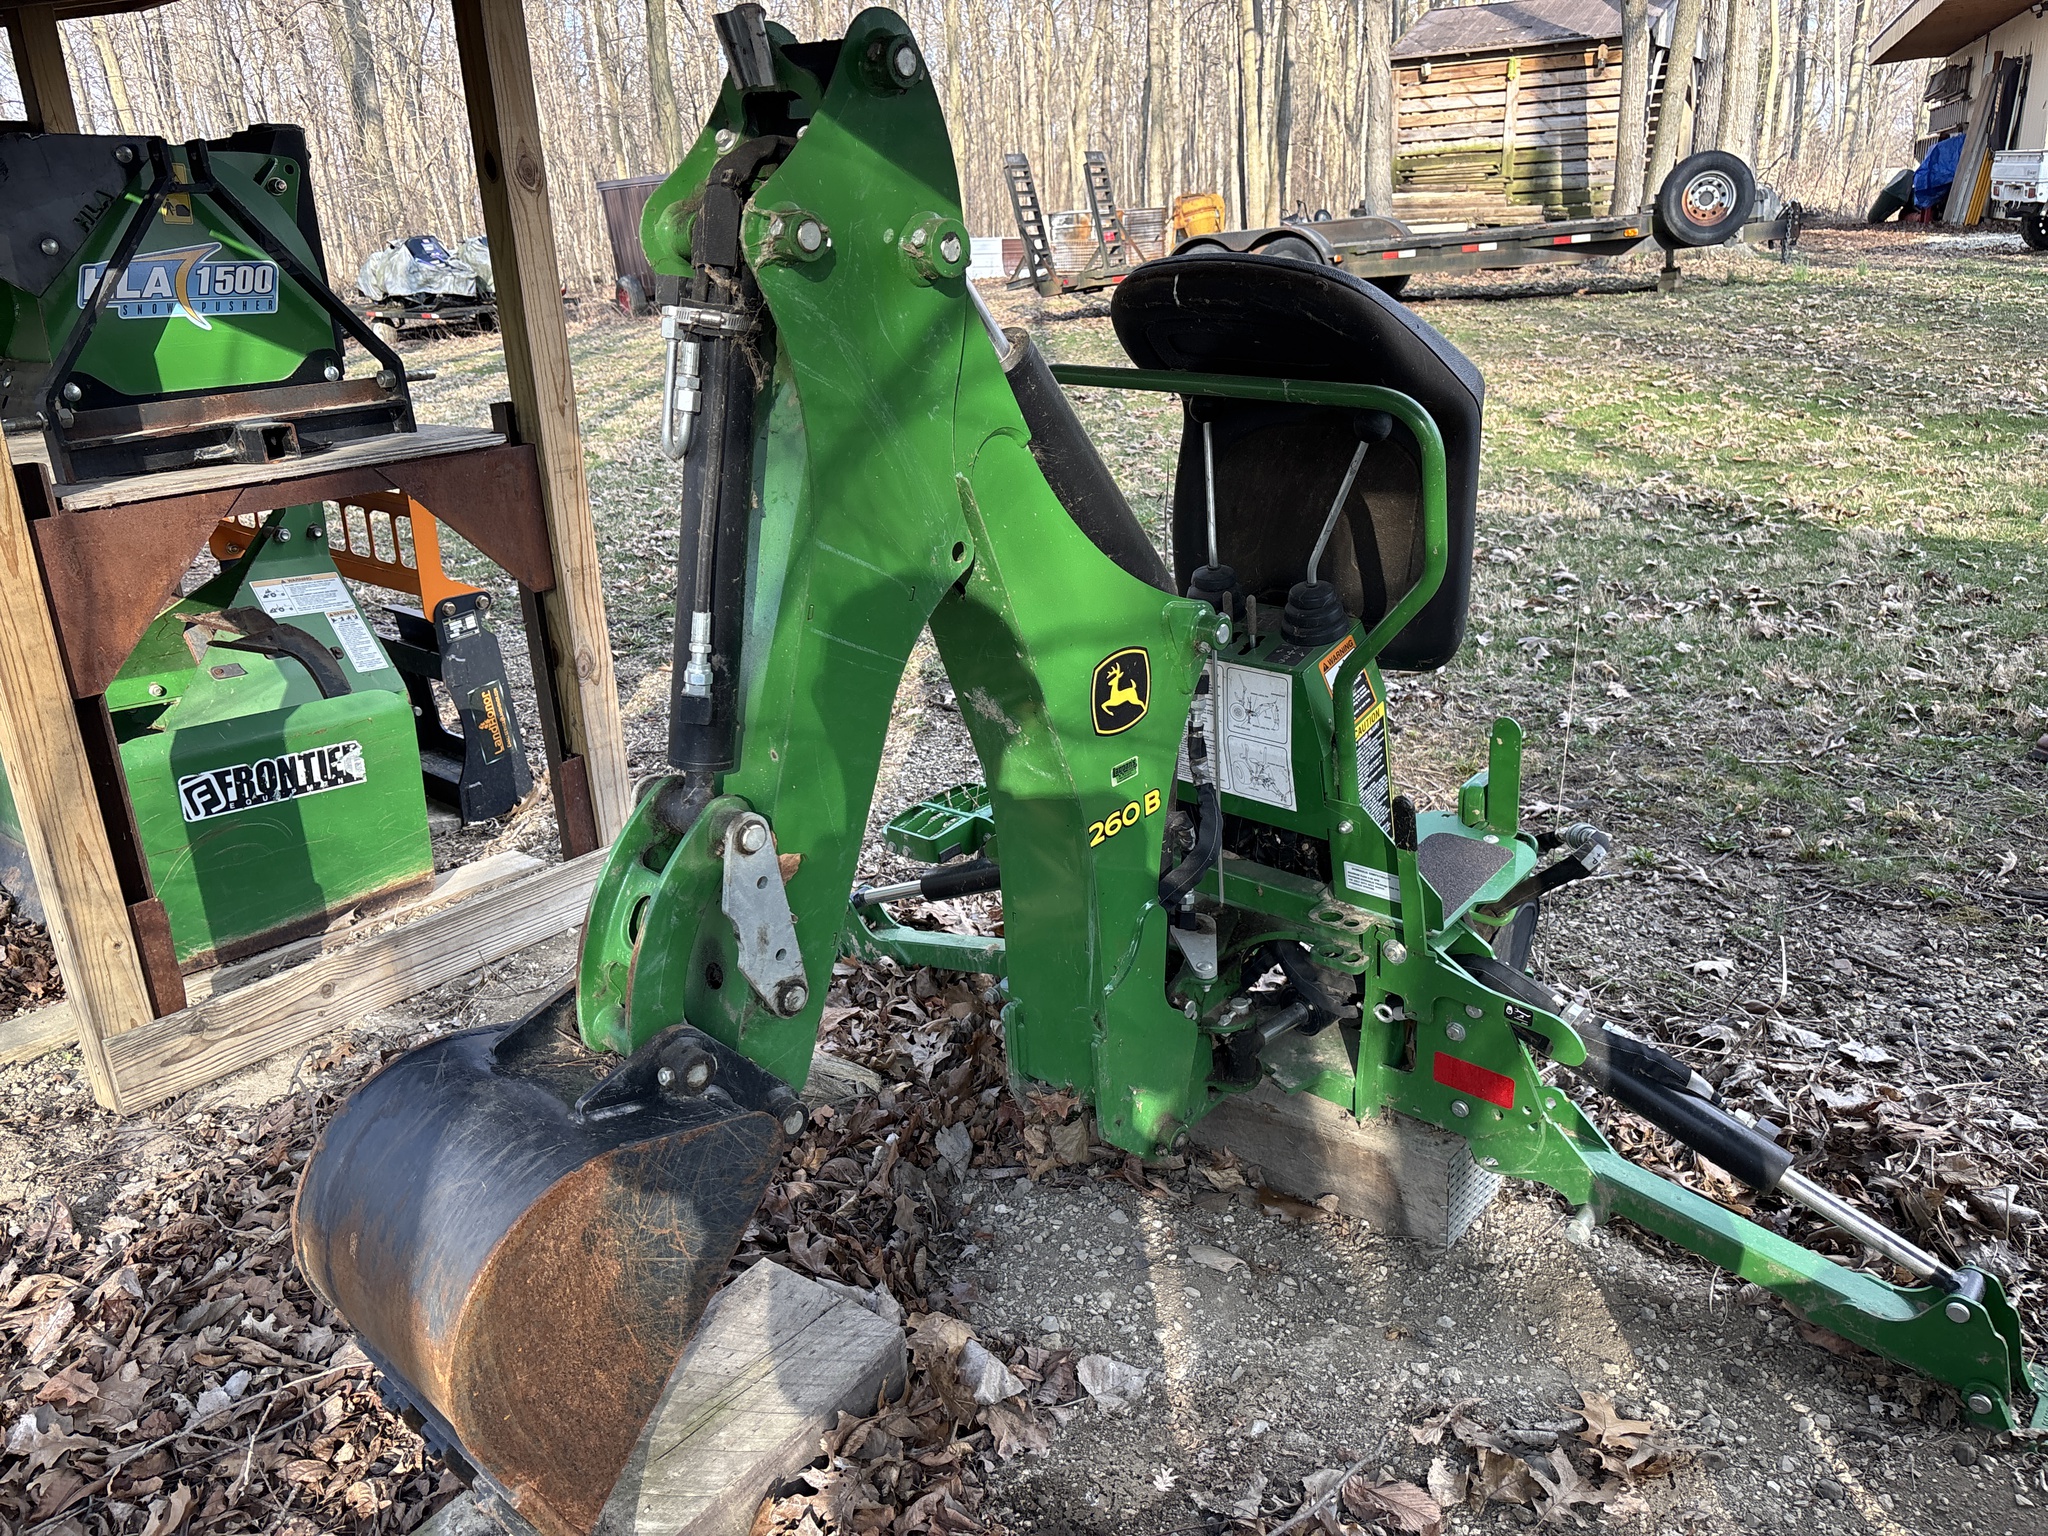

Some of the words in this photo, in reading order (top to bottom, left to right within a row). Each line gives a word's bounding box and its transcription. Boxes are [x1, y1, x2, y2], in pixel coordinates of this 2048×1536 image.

[73, 190, 114, 233] HLA
[196, 265, 273, 295] 1500
[122, 302, 173, 316] SNOW
[201, 300, 274, 312] PUSHER
[1327, 639, 1354, 666] WARNING
[481, 690, 505, 755] LandHonor
[1355, 709, 1380, 737] AUTION
[1088, 800, 1141, 848] 260
[1143, 788, 1161, 818] B
